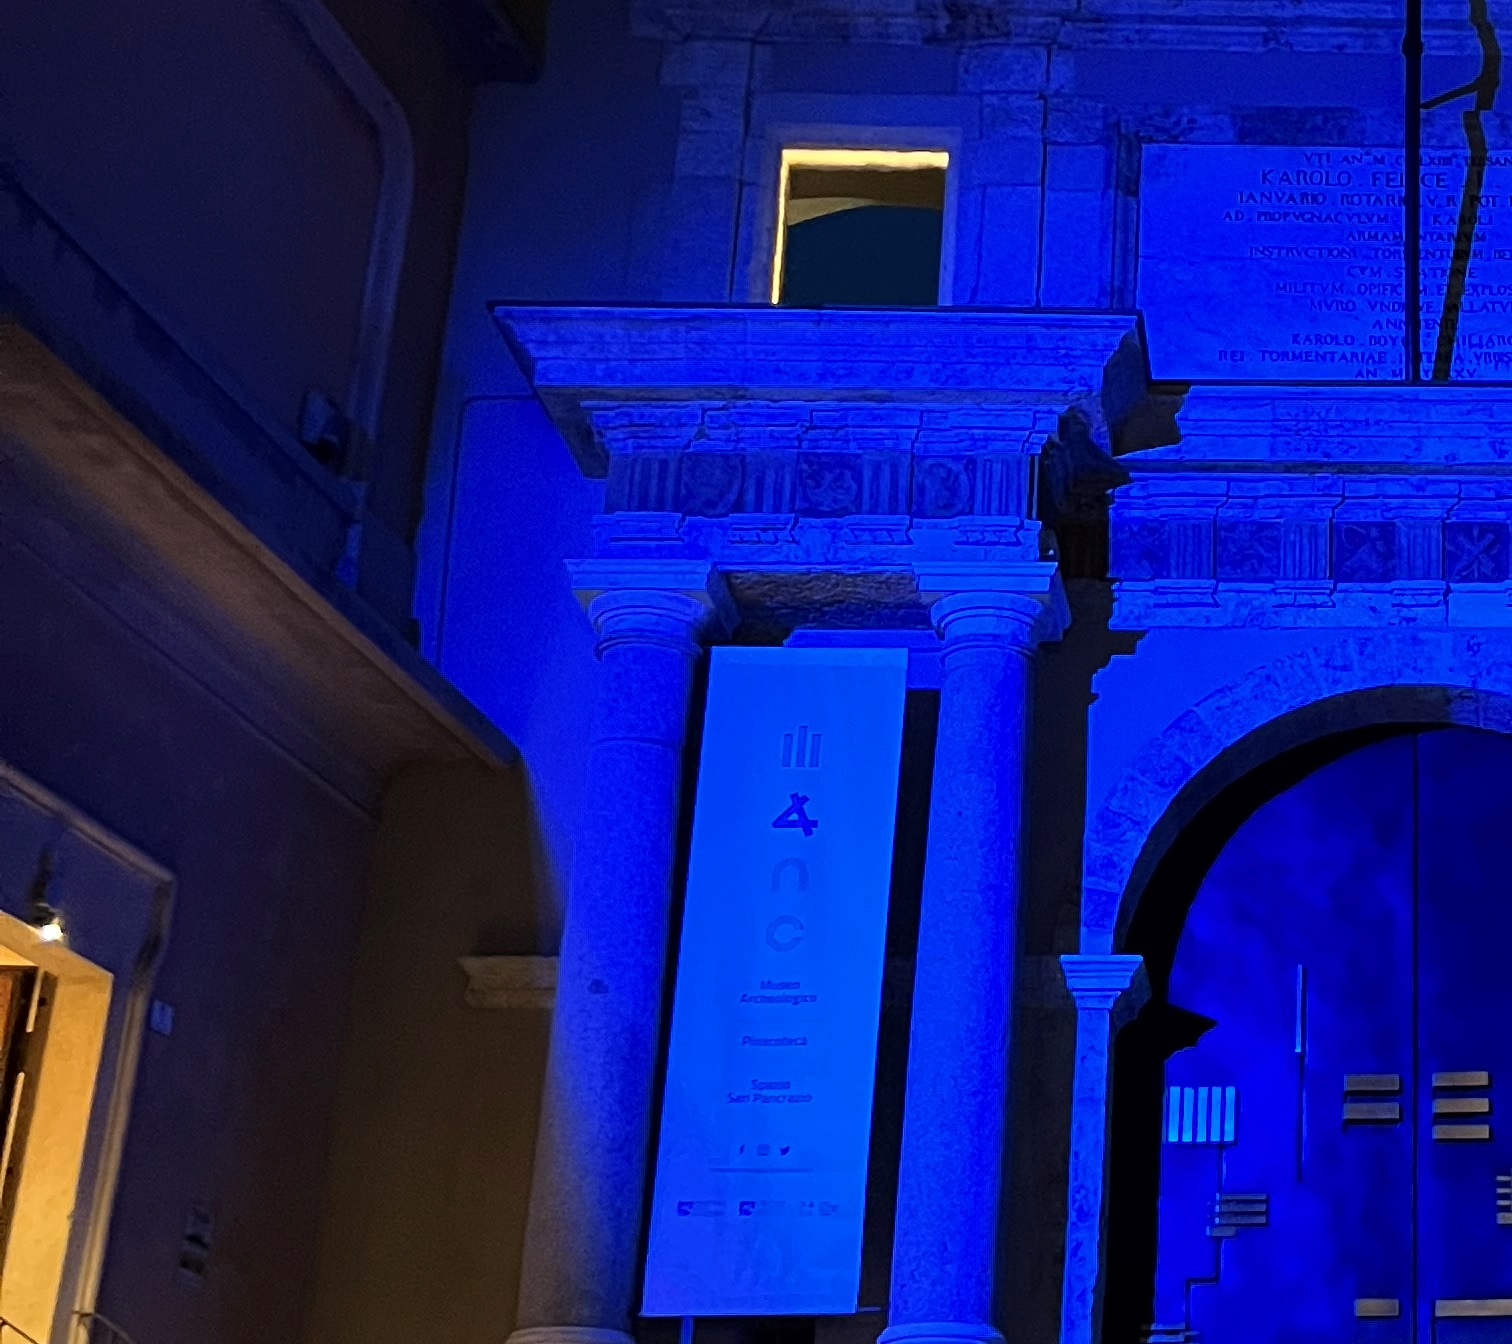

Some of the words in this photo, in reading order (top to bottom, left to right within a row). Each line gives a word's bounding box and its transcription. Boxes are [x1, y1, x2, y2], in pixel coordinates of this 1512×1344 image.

[1262, 169, 1352, 186] KAROLO
[1372, 170, 1449, 189] FELCE
[1239, 190, 1327, 205] IANVARIO
[1291, 332, 1356, 346] KAROLO
[1260, 348, 1388, 364] TORMENTARIAE
